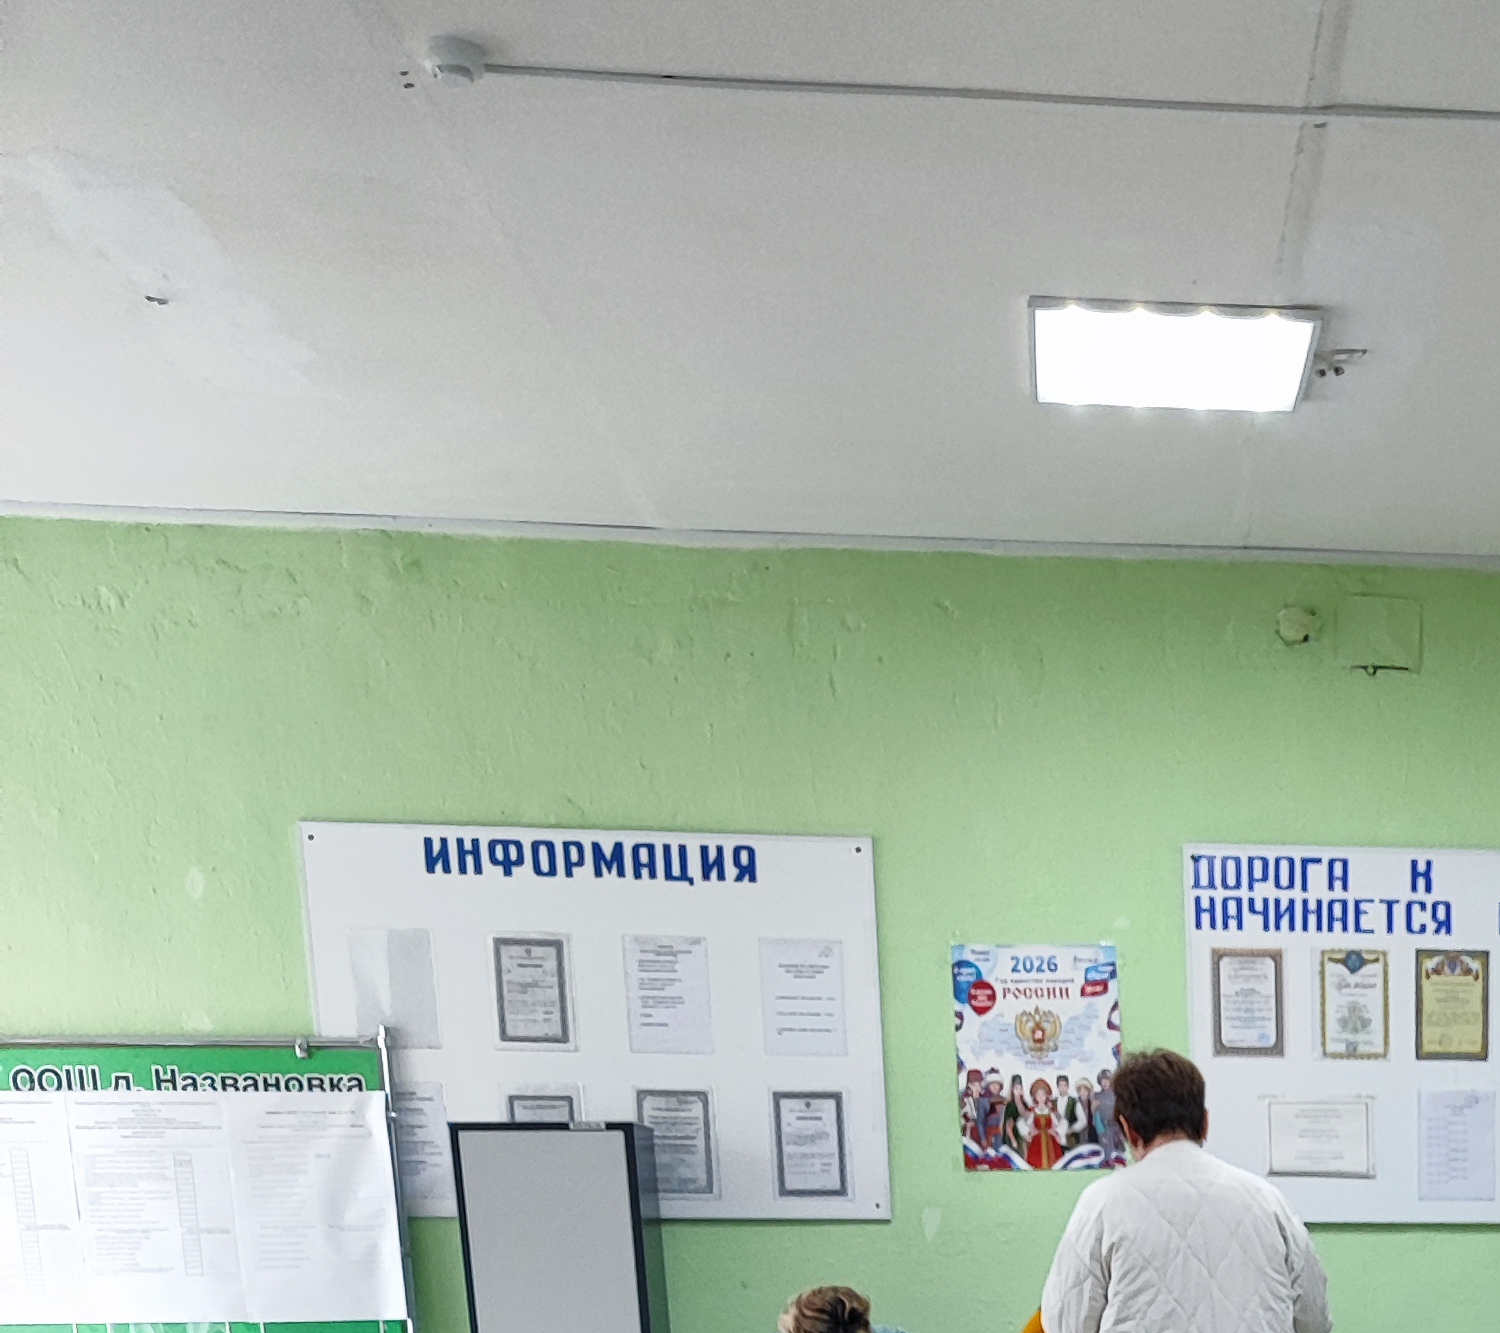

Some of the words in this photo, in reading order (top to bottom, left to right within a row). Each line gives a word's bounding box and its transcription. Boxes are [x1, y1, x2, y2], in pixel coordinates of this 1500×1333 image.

[424, 837, 758, 886] ИНФОРМАЦИЯ
[1192, 855, 1350, 893] ДОРОГА
[1411, 859, 1433, 894] К
[1195, 896, 1452, 935] НАЧИНАЕТСЯ
[1011, 955, 1058, 973] 2026
[1002, 986, 1070, 1000] РОССИИ
[11, 1067, 99, 1091] ООШ
[154, 1068, 364, 1092] Названовка
